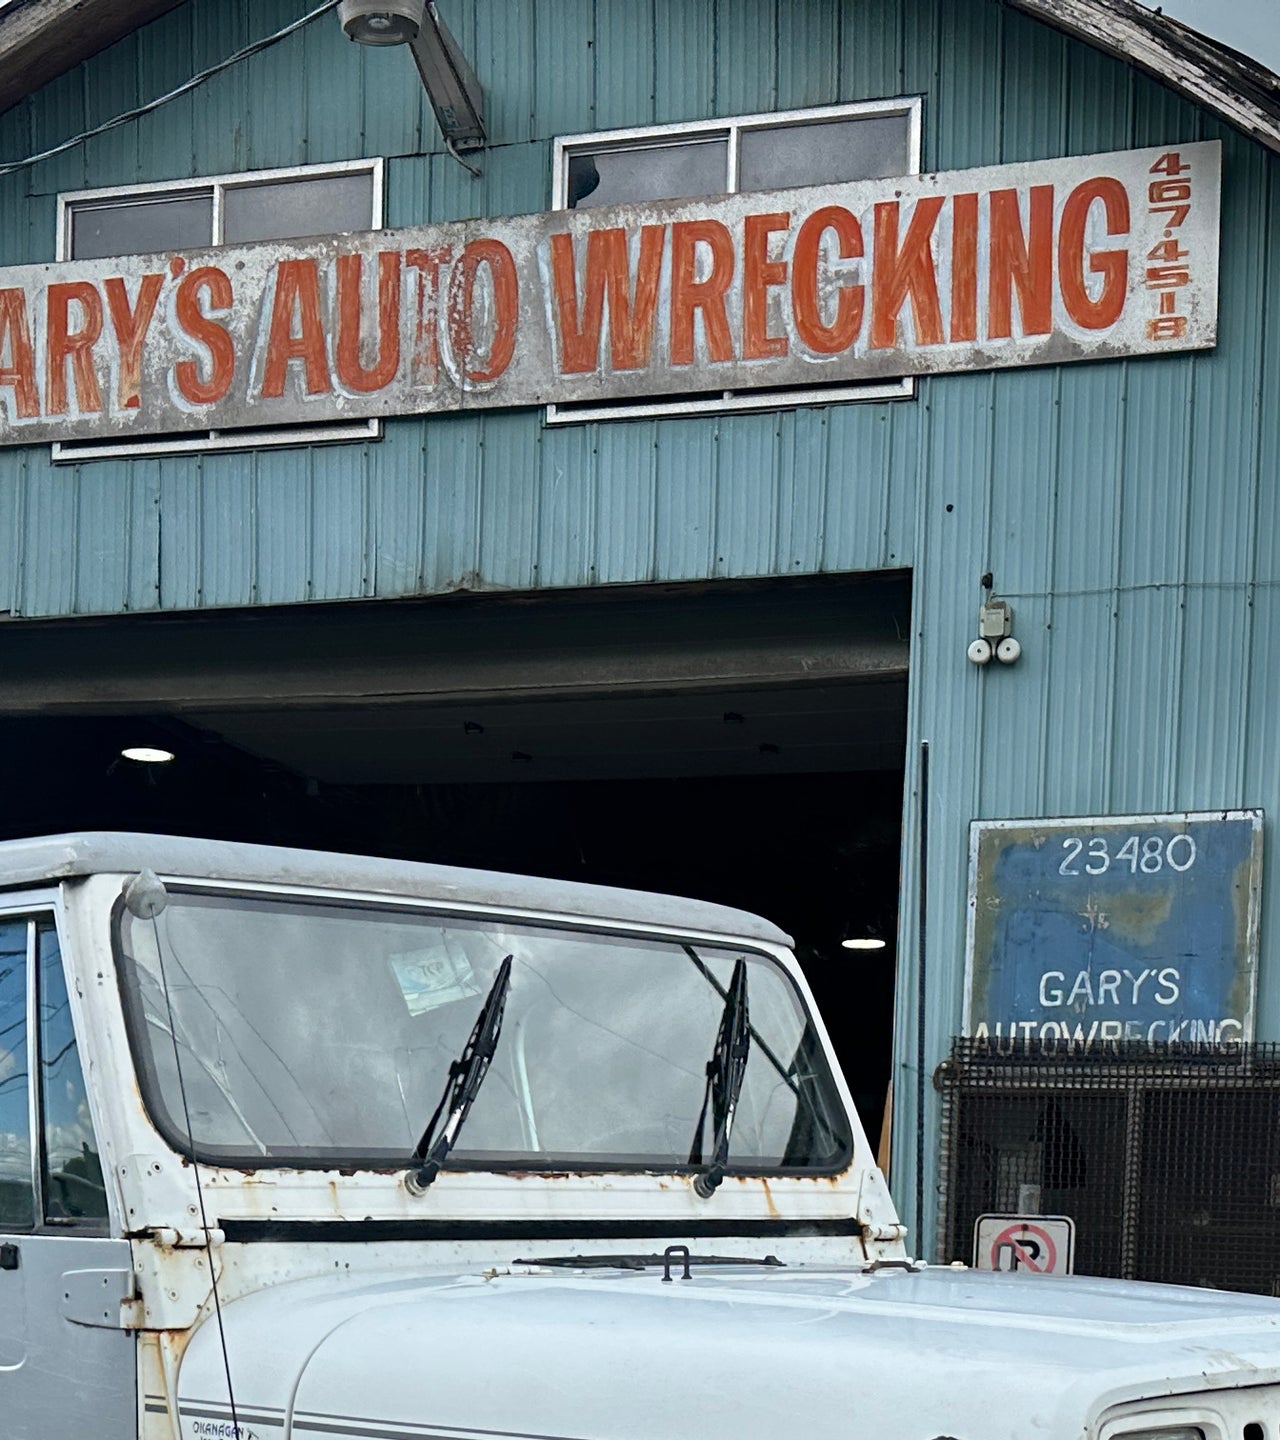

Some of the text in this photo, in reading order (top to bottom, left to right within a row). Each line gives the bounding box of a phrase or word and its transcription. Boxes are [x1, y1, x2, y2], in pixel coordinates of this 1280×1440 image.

[261, 238, 518, 399] AUTO
[551, 176, 1130, 375] WRECKING
[1058, 834, 1197, 876] 23480
[1039, 967, 1181, 1007] GARY'S
